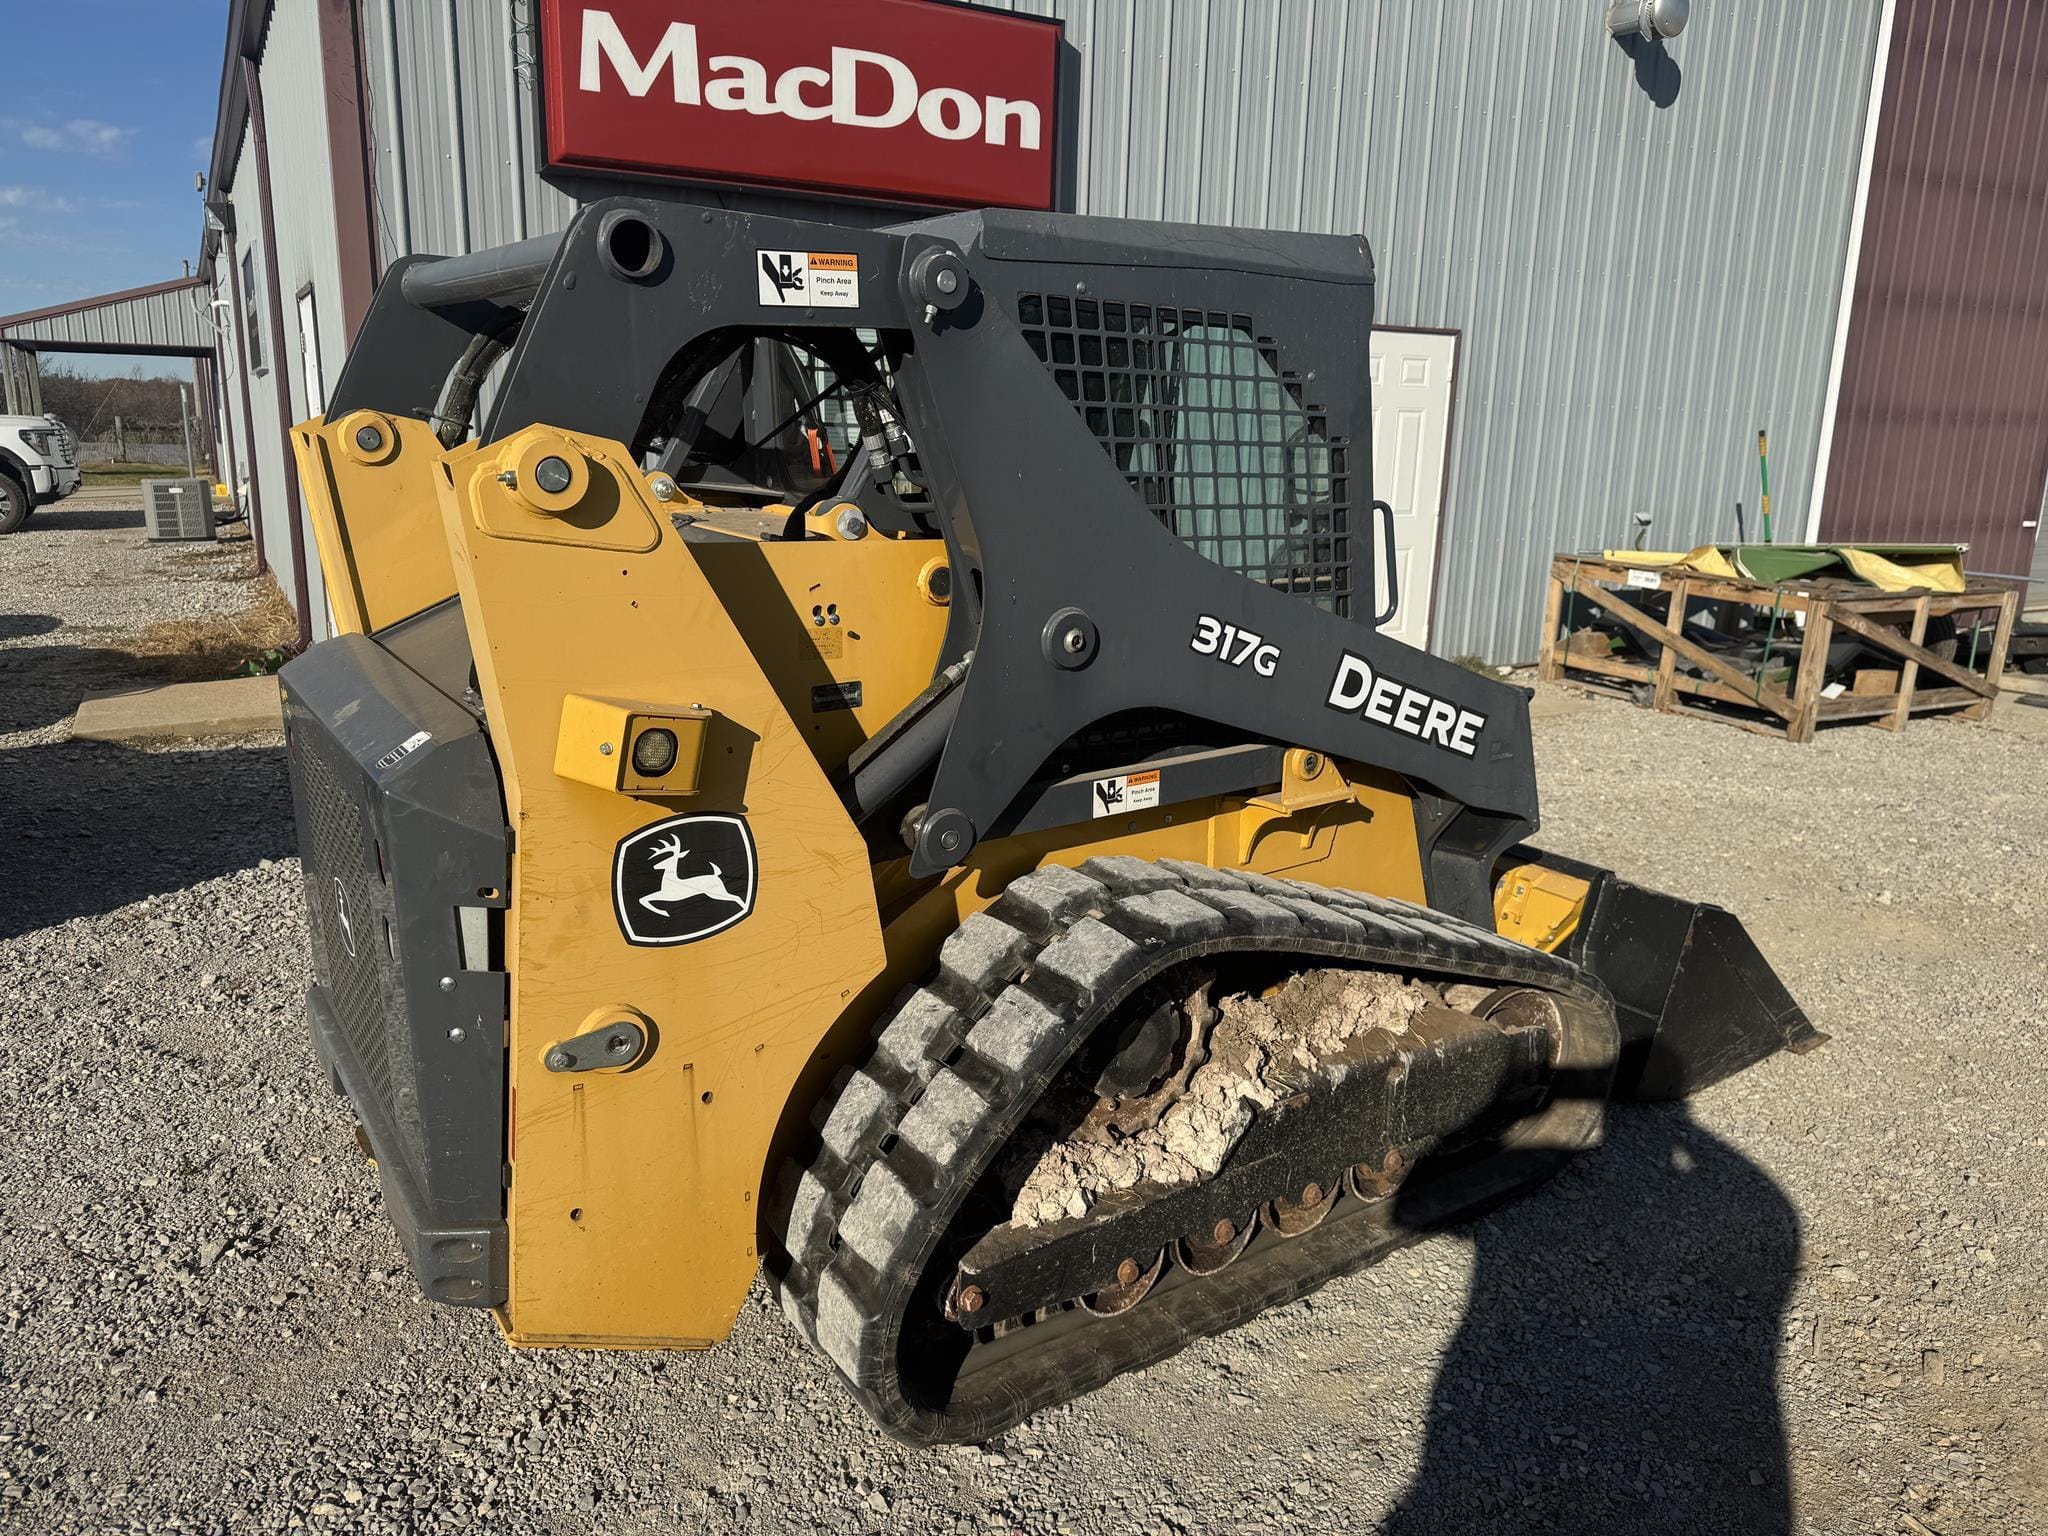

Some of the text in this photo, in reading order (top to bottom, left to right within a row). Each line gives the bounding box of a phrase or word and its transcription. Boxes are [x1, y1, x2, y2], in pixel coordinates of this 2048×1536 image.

[579, 9, 1041, 150] MacDon
[818, 258, 854, 267] WARNING
[816, 276, 852, 285] Pinch Area
[820, 290, 834, 298] Keep
[1191, 616, 1281, 677] 317G
[1133, 773, 1157, 782] WARNING
